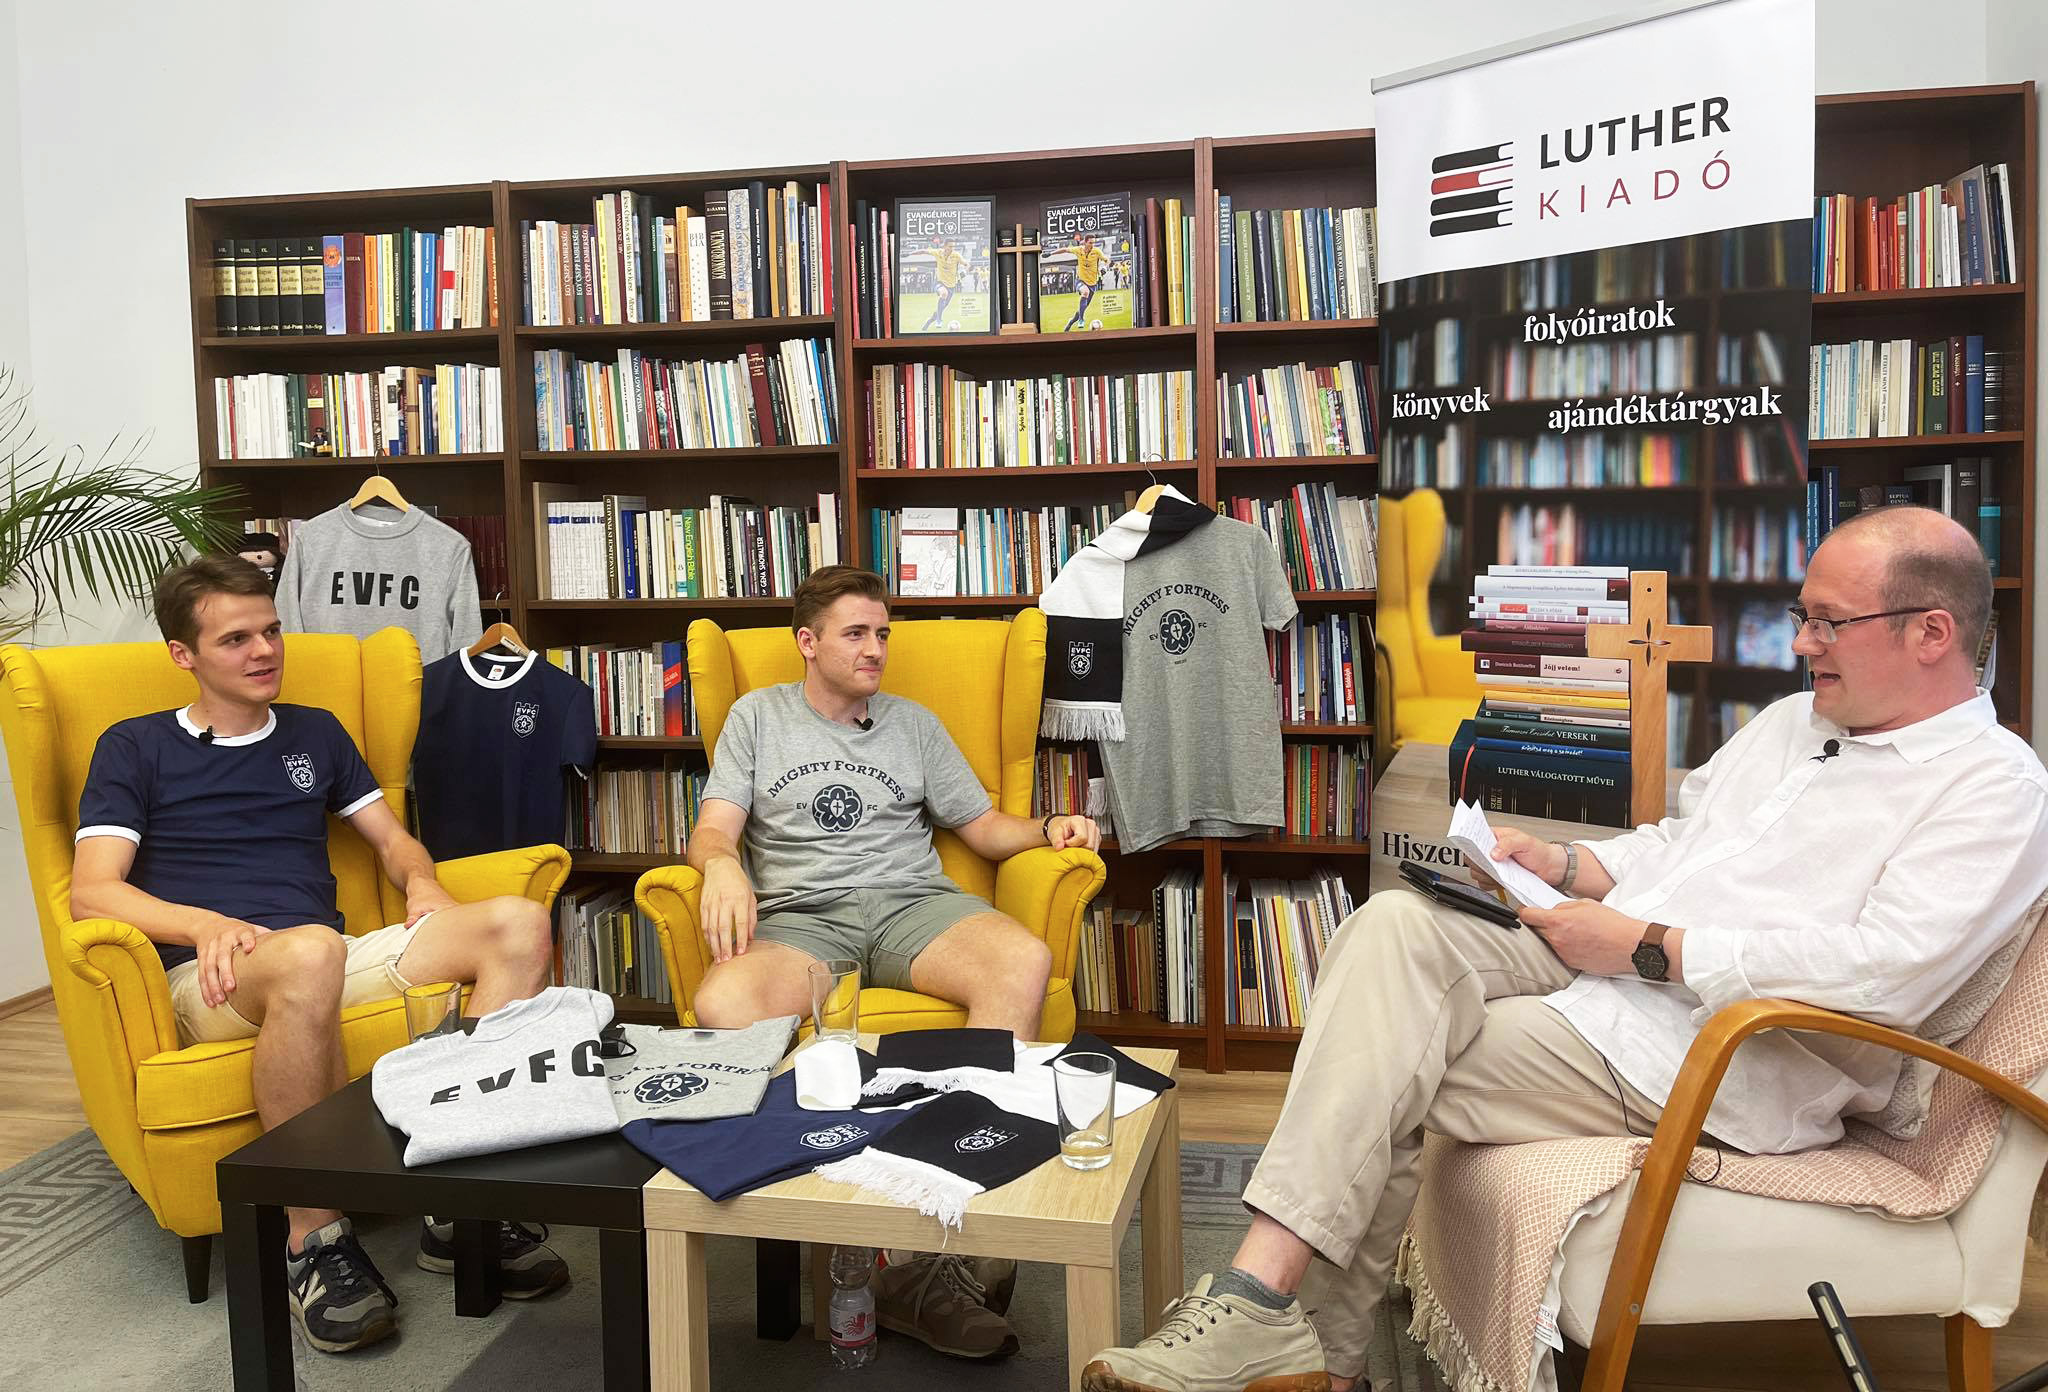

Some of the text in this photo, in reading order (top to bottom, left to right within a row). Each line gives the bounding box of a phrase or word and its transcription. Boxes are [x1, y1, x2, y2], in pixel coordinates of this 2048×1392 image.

[1539, 96, 1731, 170] LUTHER
[1539, 150, 1730, 219] KIADÓ
[906, 210, 957, 219] EVANGÉLIKUS
[1047, 205, 1097, 218] EVANGÉLIKUS
[710, 230, 726, 279] KONKORDANCIA
[1523, 300, 1676, 344] folyóiratok
[1392, 386, 1782, 434] könyvek ajándéktárgyak
[685, 535, 693, 560] English
[331, 571, 419, 610] EVFC
[1123, 583, 1230, 637] MIGHTY FORTRESS
[1344, 668, 1352, 688] Biddulph
[517, 707, 537, 716] EVFC
[1556, 731, 1588, 740] VERSEK
[286, 759, 310, 767] EVFC
[1498, 767, 1614, 786] LUTHER VÁLOGATOTT MŰVEI
[767, 760, 906, 802] MIGHTY FORTRESS
[796, 802, 808, 810] EV
[430, 1040, 606, 1105] EVFC
